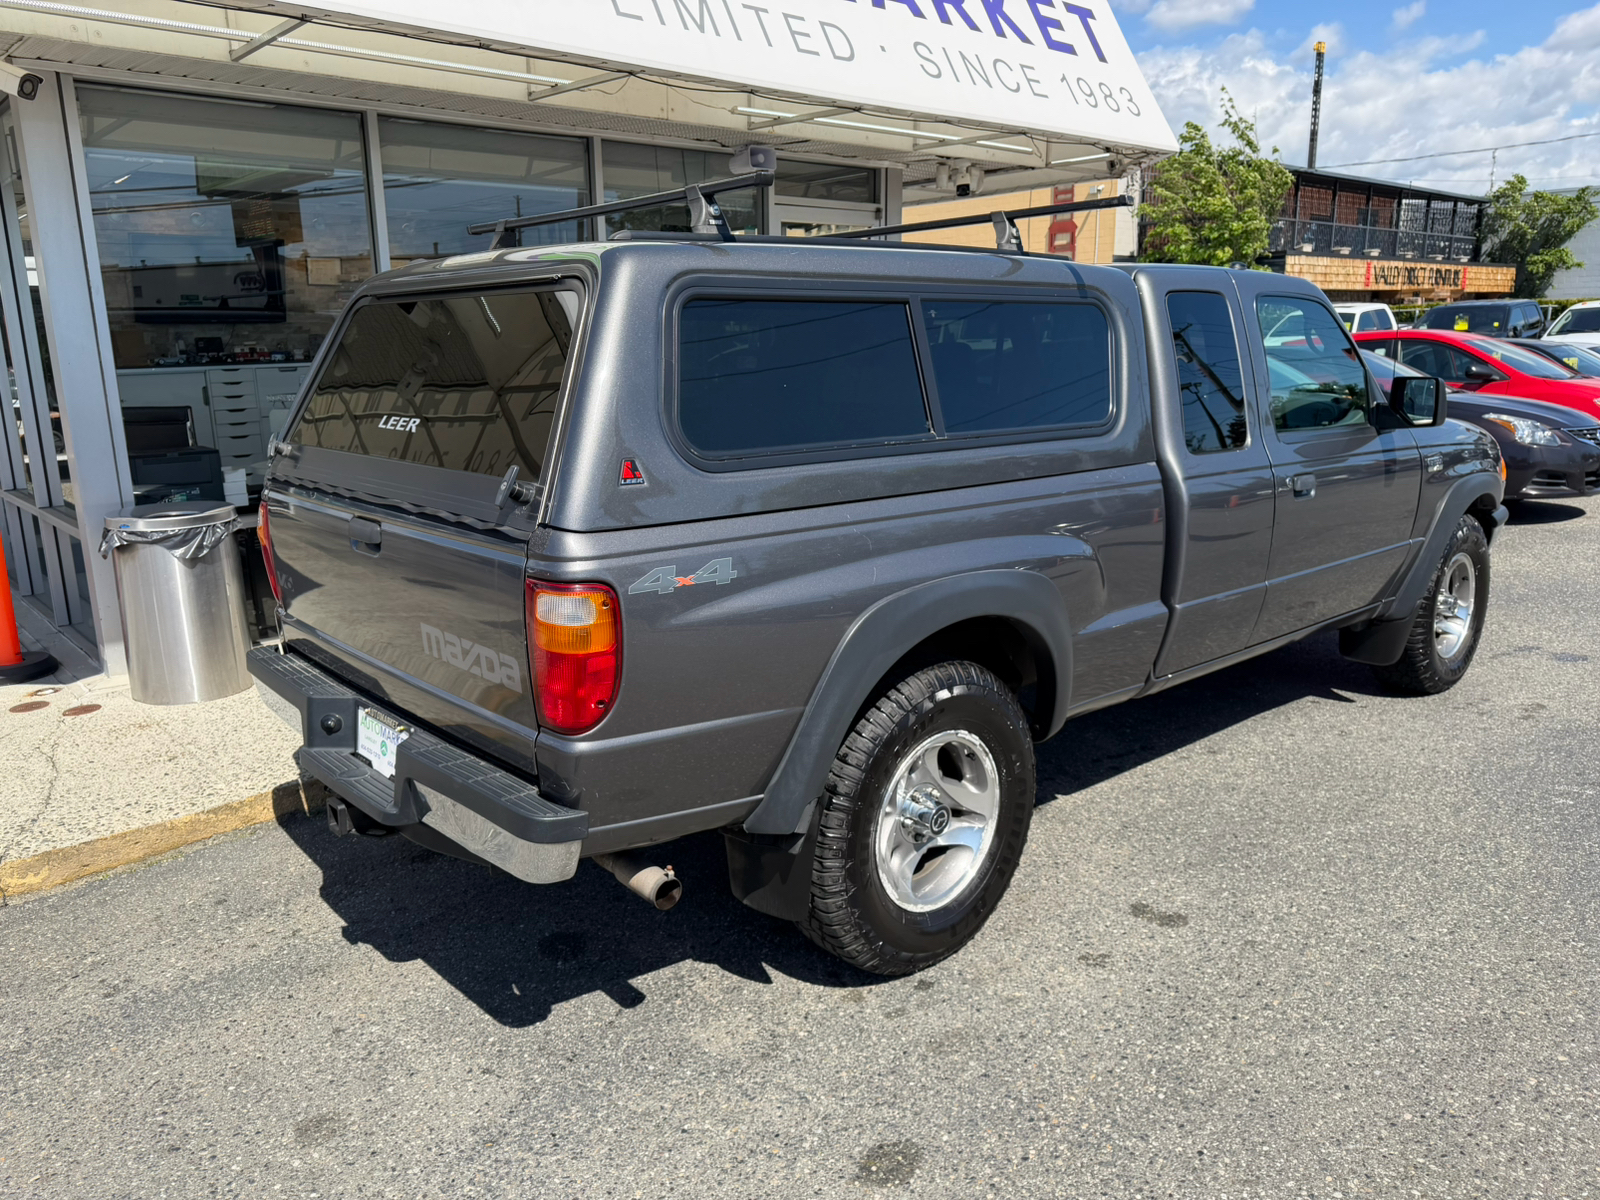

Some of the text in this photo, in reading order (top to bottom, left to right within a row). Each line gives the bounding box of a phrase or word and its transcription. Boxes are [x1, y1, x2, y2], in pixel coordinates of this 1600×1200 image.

[913, 41, 1049, 99] SINCE
[1060, 73, 1141, 117] 1983
[378, 415, 421, 433] LEER
[628, 557, 737, 595] 4x4
